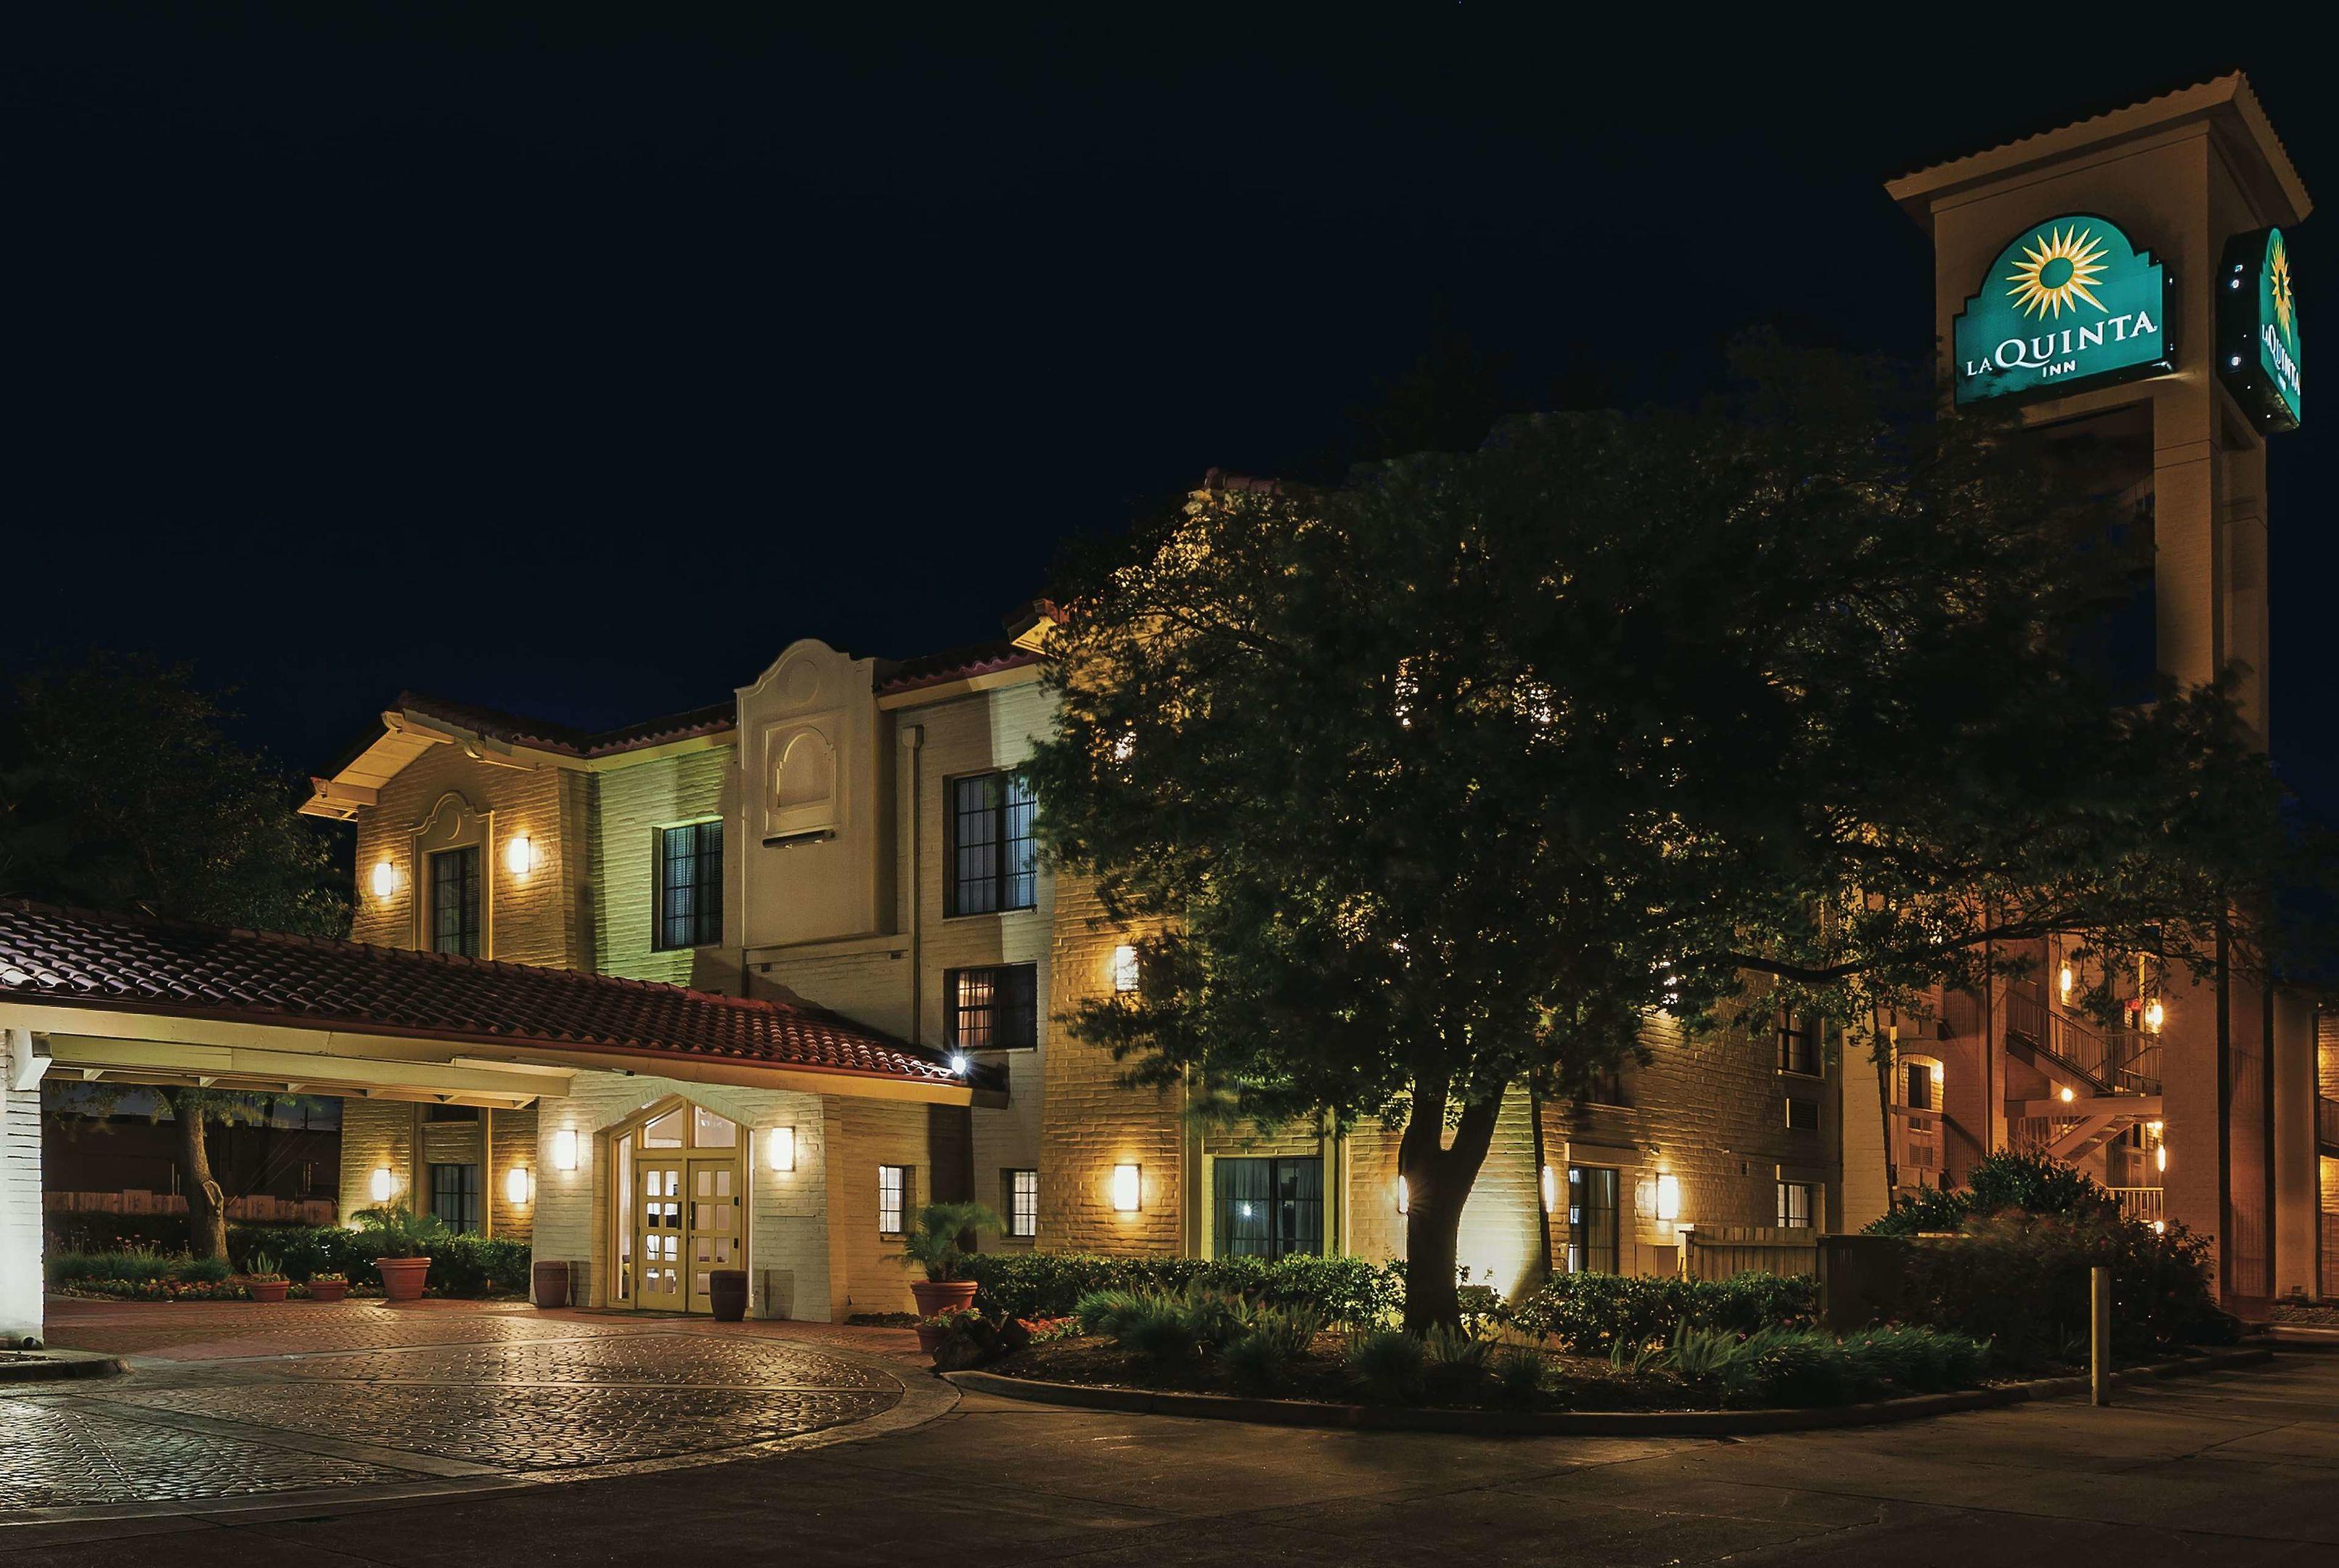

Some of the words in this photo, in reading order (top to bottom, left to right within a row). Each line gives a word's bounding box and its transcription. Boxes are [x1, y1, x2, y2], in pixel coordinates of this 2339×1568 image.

[1967, 357, 1993, 377] LA
[1994, 311, 2158, 369] QUINTA
[2042, 360, 2076, 378] INN
